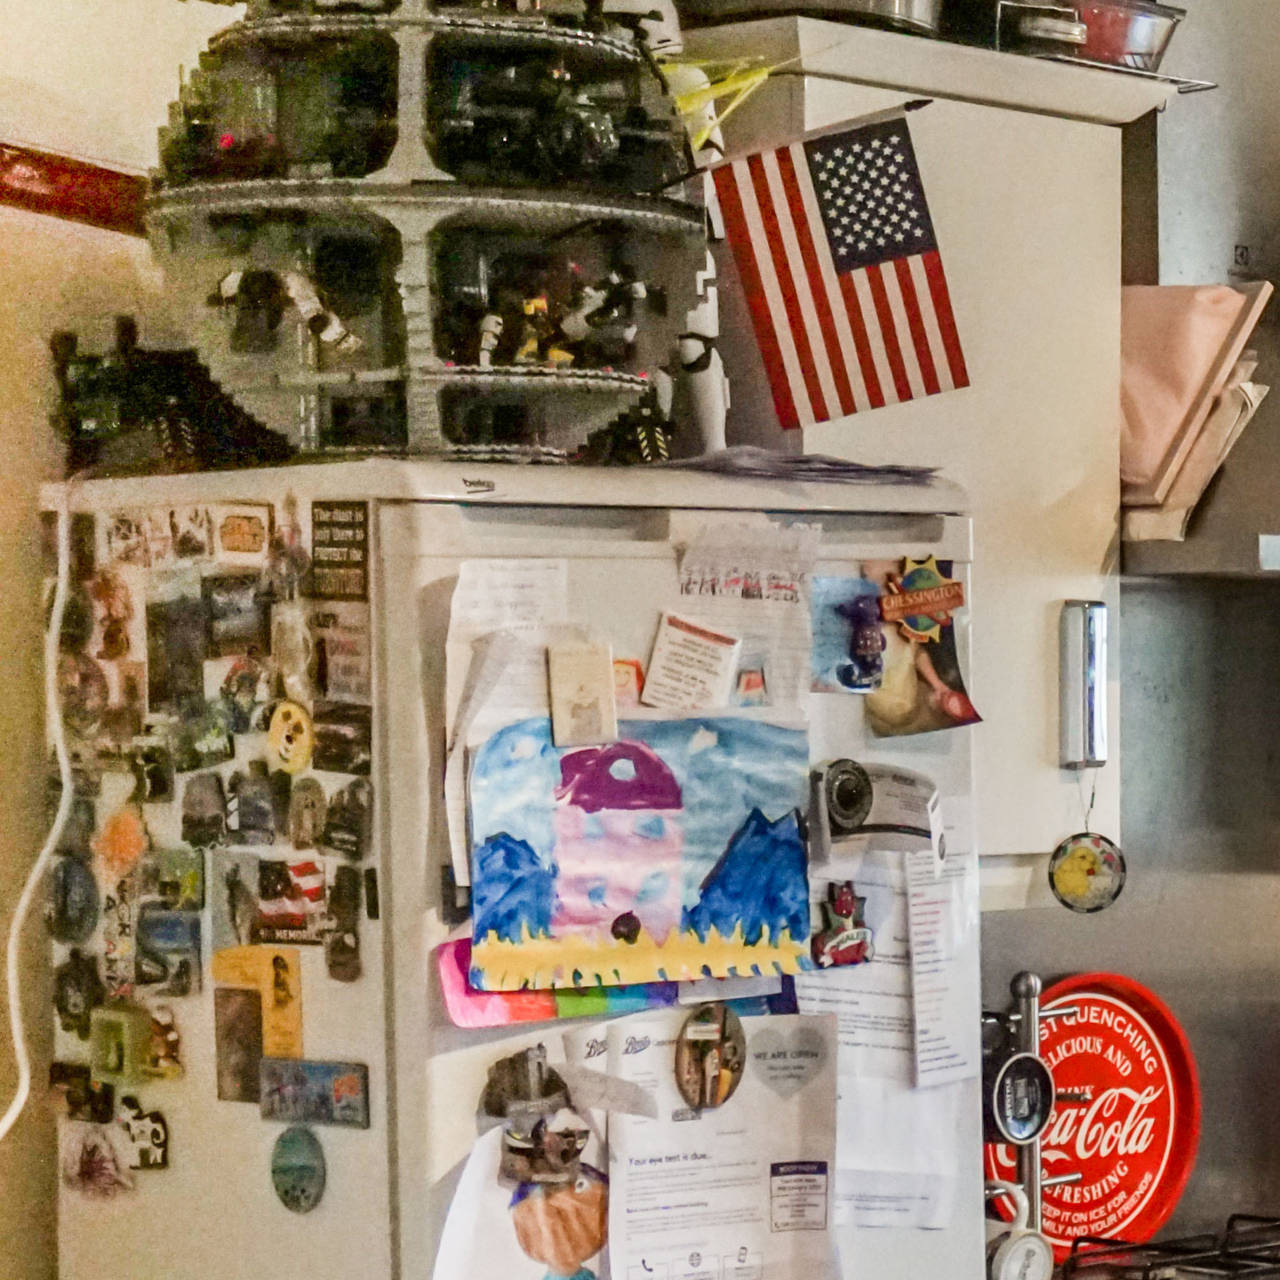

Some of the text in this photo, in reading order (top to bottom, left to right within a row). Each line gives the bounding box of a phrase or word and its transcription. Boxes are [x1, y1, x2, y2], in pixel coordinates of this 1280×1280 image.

[883, 582, 962, 609] CHESSINGTON
[1103, 1045, 1132, 1077] AND
[1072, 1211, 1088, 1223] ON
[1107, 1190, 1127, 1211] FOR
[1065, 1222, 1089, 1236] AND
